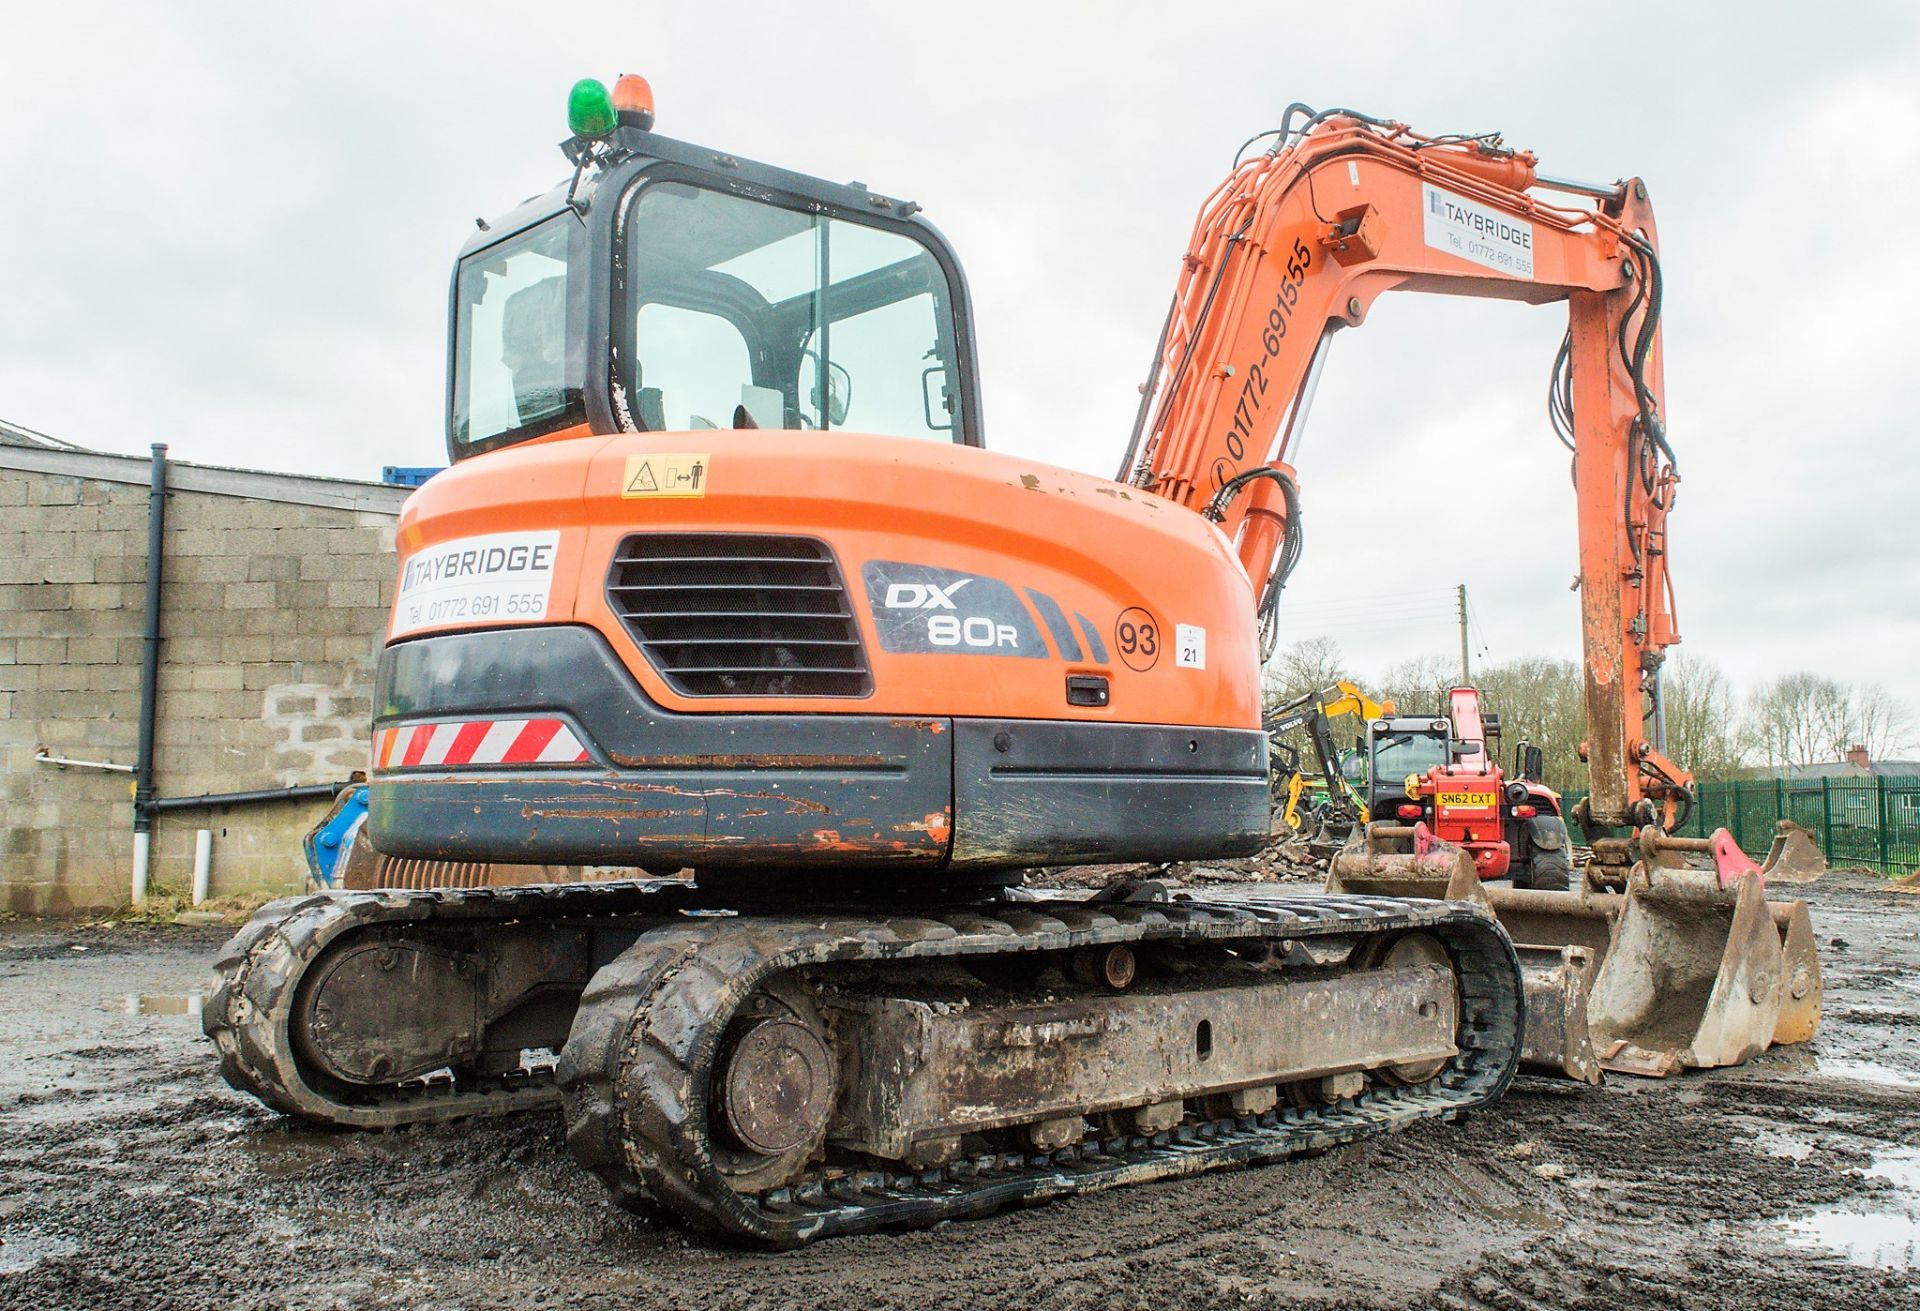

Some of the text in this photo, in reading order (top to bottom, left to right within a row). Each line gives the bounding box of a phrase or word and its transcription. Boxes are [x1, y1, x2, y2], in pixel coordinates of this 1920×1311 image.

[1445, 203, 1531, 249] TAYBRIDGE
[1469, 241, 1495, 261] 01772
[1497, 251, 1513, 266] 691
[1516, 258, 1532, 274] 555
[1226, 237, 1311, 461] 01772-691555
[415, 545, 552, 586] TAYBRIDGE
[428, 598, 468, 621] 01772
[472, 595, 500, 615] 691
[507, 594, 543, 614] 555
[885, 578, 974, 609] DX
[928, 615, 1018, 648] 80R
[1119, 622, 1156, 656] 93
[1184, 647, 1196, 662] 21
[1441, 794, 1491, 804] SN62 CXT
